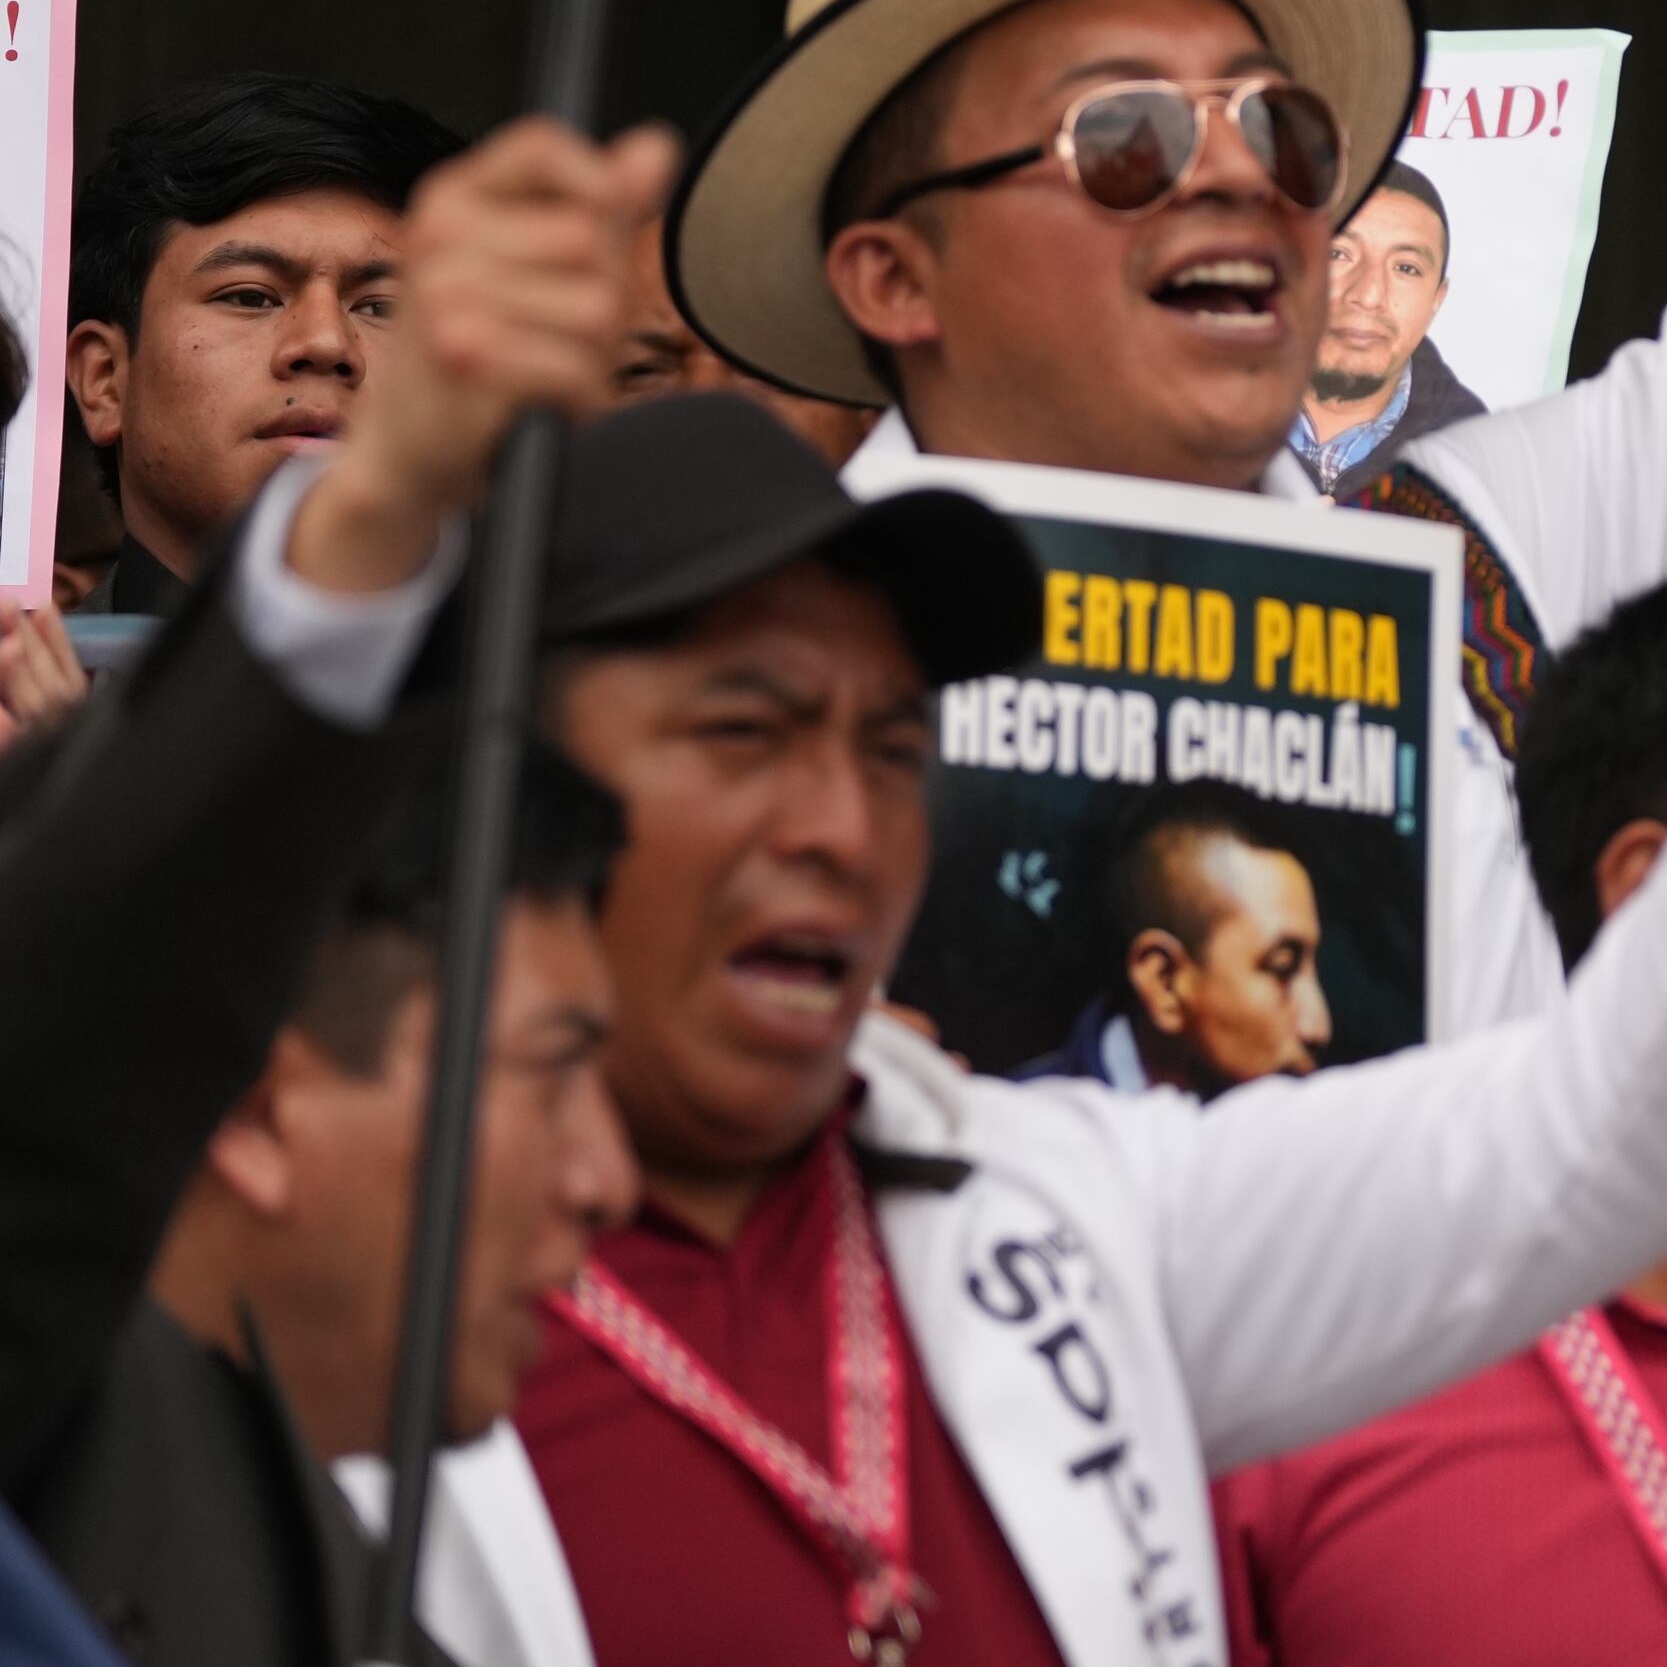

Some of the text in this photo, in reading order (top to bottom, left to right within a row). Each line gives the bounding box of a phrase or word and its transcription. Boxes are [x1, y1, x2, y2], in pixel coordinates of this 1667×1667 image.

[1406, 78, 1570, 139] TAD!
[1043, 568, 1399, 708] ERTAD PARA
